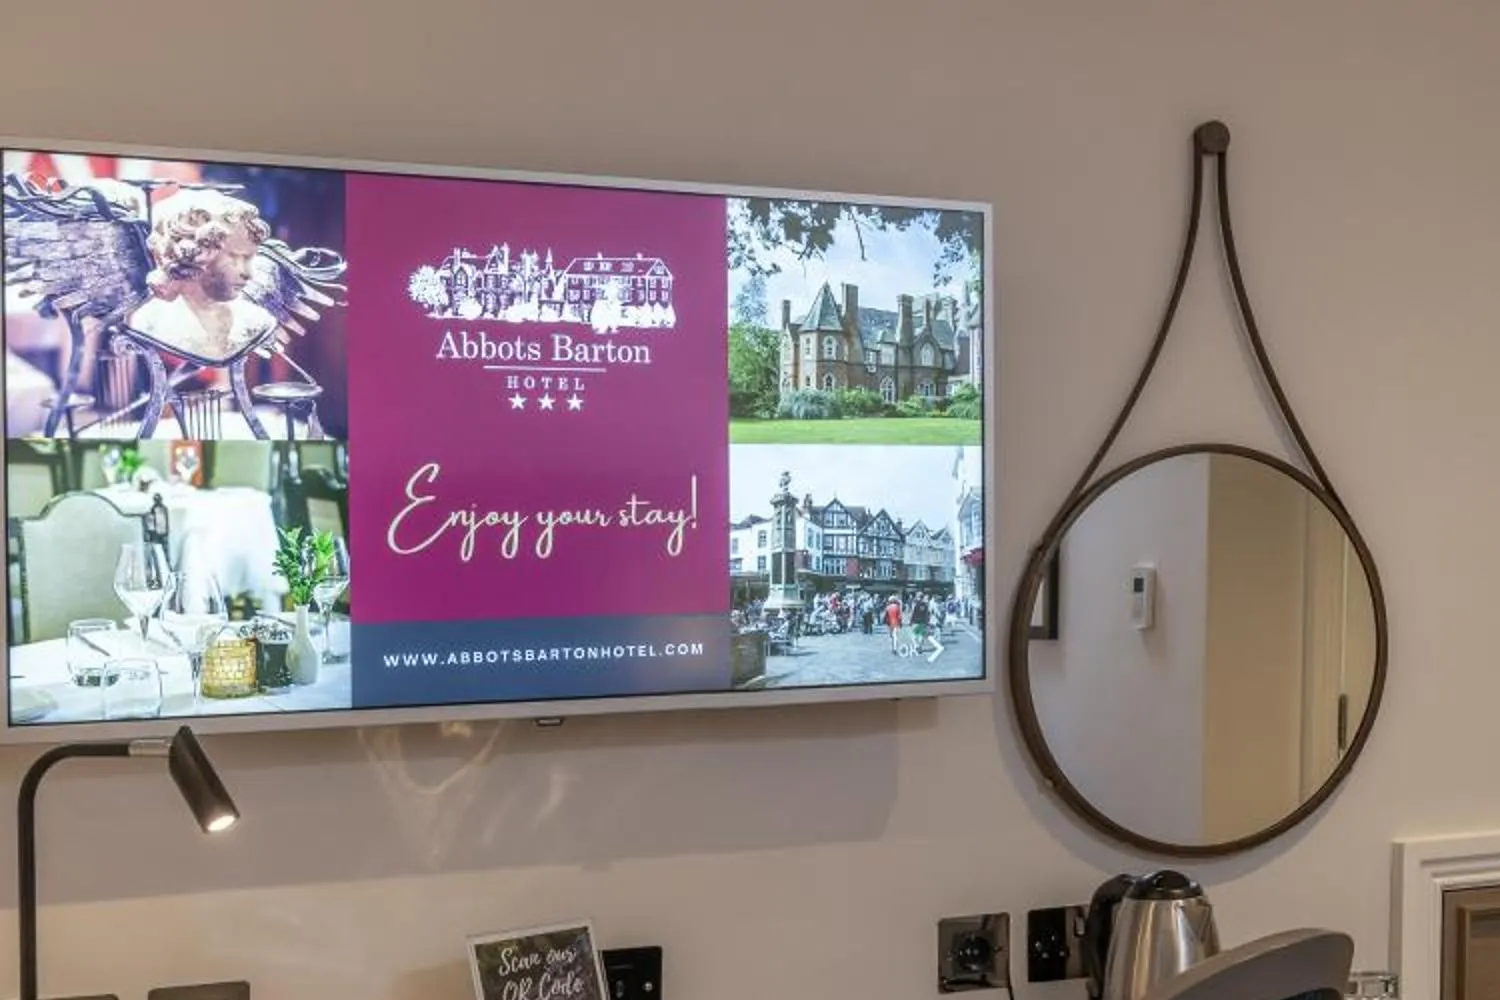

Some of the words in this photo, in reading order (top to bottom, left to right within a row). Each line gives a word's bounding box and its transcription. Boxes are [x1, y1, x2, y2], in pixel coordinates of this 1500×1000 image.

[436, 329, 541, 362] Abbots
[551, 333, 652, 364] Barton
[506, 375, 585, 392] HOTEL
[387, 462, 528, 562] Enjoy
[535, 506, 612, 559] your
[618, 474, 698, 557] stay!
[383, 642, 704, 668] WWW.ABBOTSBARTONHOTEL.COM
